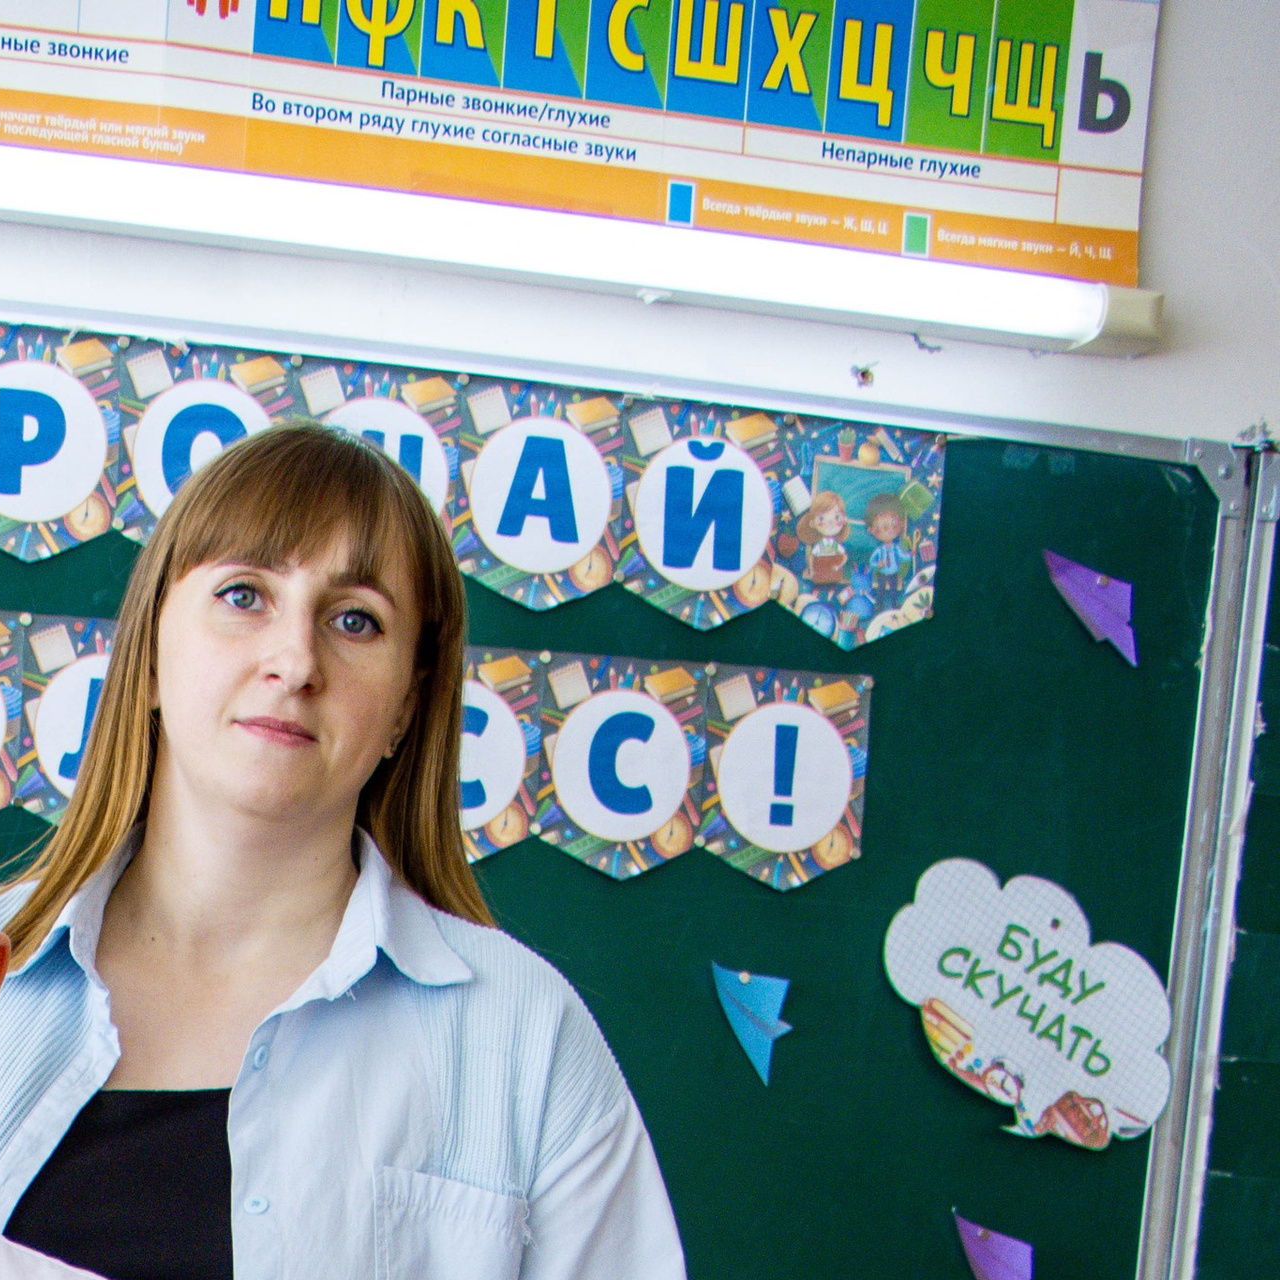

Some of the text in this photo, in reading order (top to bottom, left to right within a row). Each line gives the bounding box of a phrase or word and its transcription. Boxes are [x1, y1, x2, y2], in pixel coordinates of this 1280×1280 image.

[47, 41, 129, 63] звонкие
[607, 0, 650, 72] С
[673, 0, 744, 87] Ш
[760, 7, 818, 95] Х
[838, 17, 894, 128] Ц
[923, 29, 977, 118] Ч
[989, 37, 1060, 149] Щ
[251, 92, 637, 163] Во втором ряду глухие согласные звуки
[381, 80, 611, 128] Парные звонкие/глухие
[821, 141, 981, 180] Непарные глухие
[996, 924, 1105, 1006] БУДУ
[937, 946, 1111, 1077] СКУЧАТЬ
